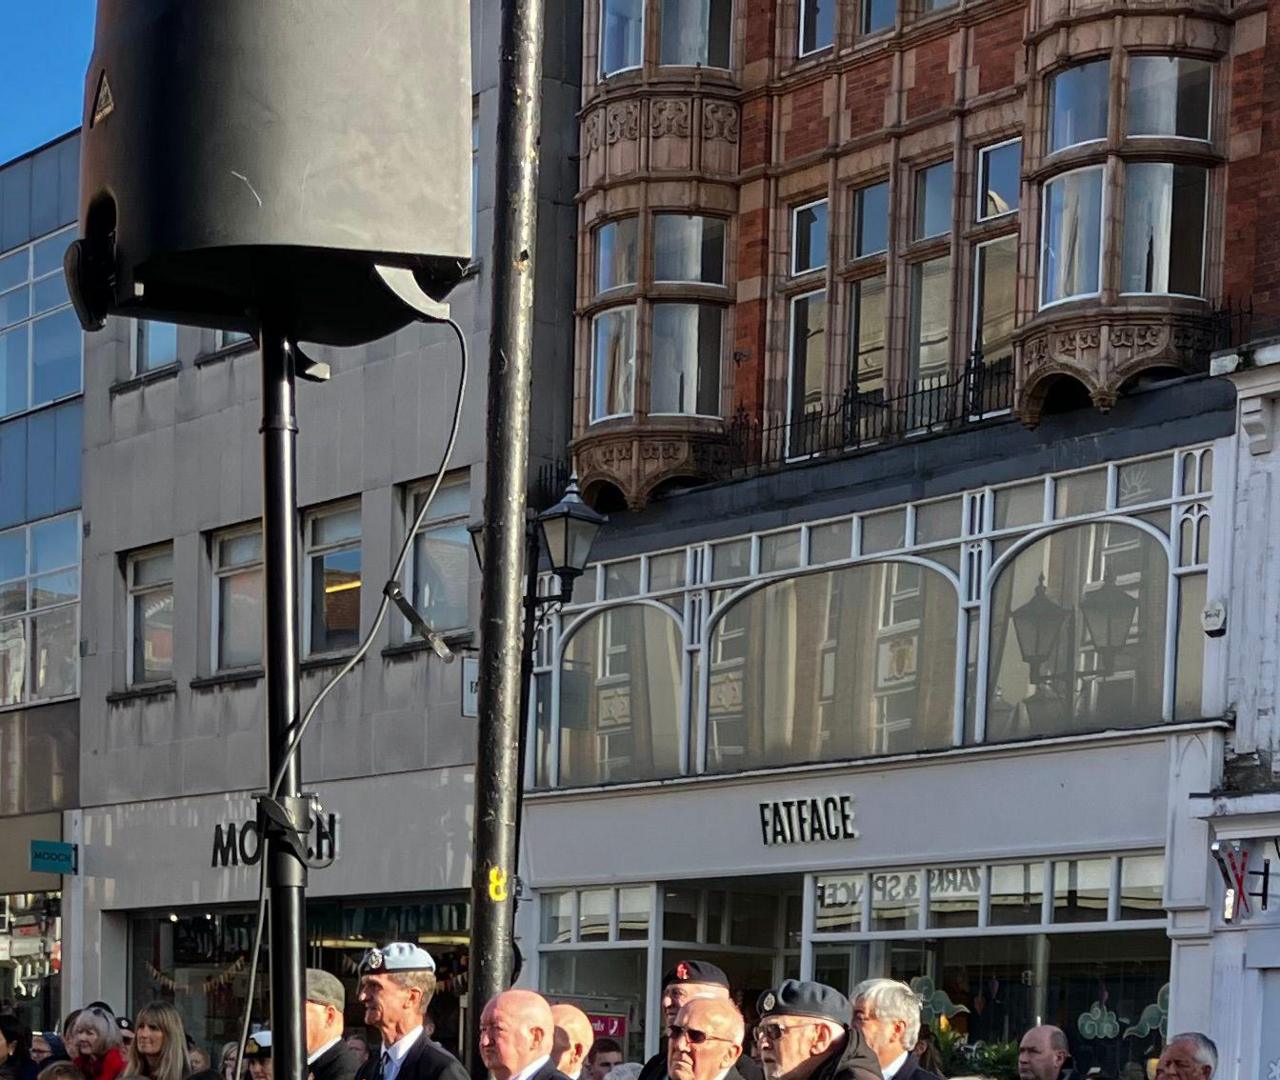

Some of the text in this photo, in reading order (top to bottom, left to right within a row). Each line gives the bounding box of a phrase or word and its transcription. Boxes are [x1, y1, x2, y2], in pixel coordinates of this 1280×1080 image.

[212, 813, 336, 867] MOH
[760, 796, 855, 845] FATFACE
[489, 867, 507, 901] 8
